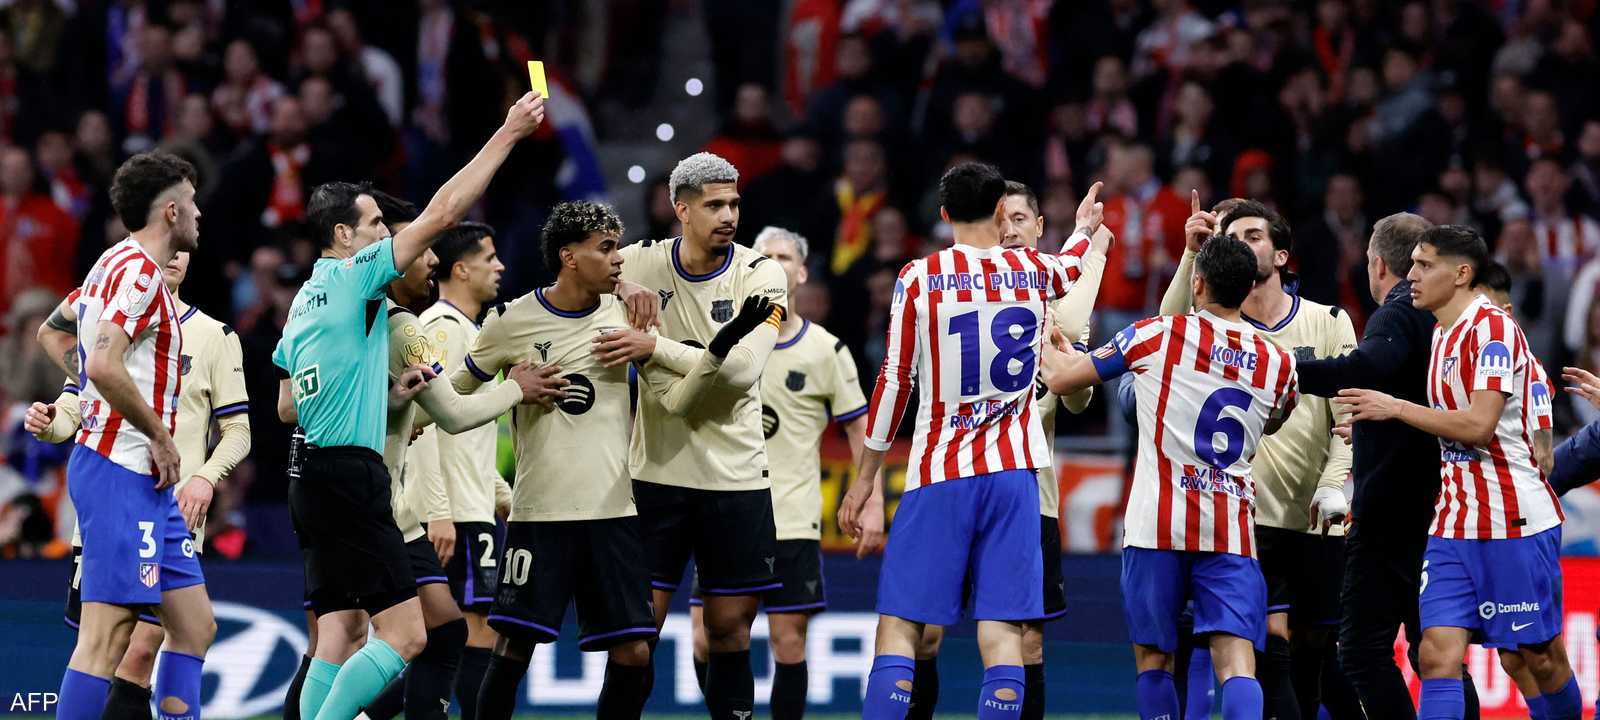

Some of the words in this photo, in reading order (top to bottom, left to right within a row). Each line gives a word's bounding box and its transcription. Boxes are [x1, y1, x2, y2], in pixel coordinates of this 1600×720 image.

[928, 274, 984, 291] MARC
[990, 272, 1047, 290] PUBILL
[948, 306, 1038, 397] 18
[1210, 344, 1258, 371] KOKE
[1479, 367, 1512, 378] kraken
[1194, 387, 1254, 470] 6
[138, 521, 157, 559] 3
[478, 532, 497, 568] 2
[502, 547, 533, 586] 10
[1498, 601, 1540, 614] ComAve
[984, 699, 1019, 712] ATLETI
